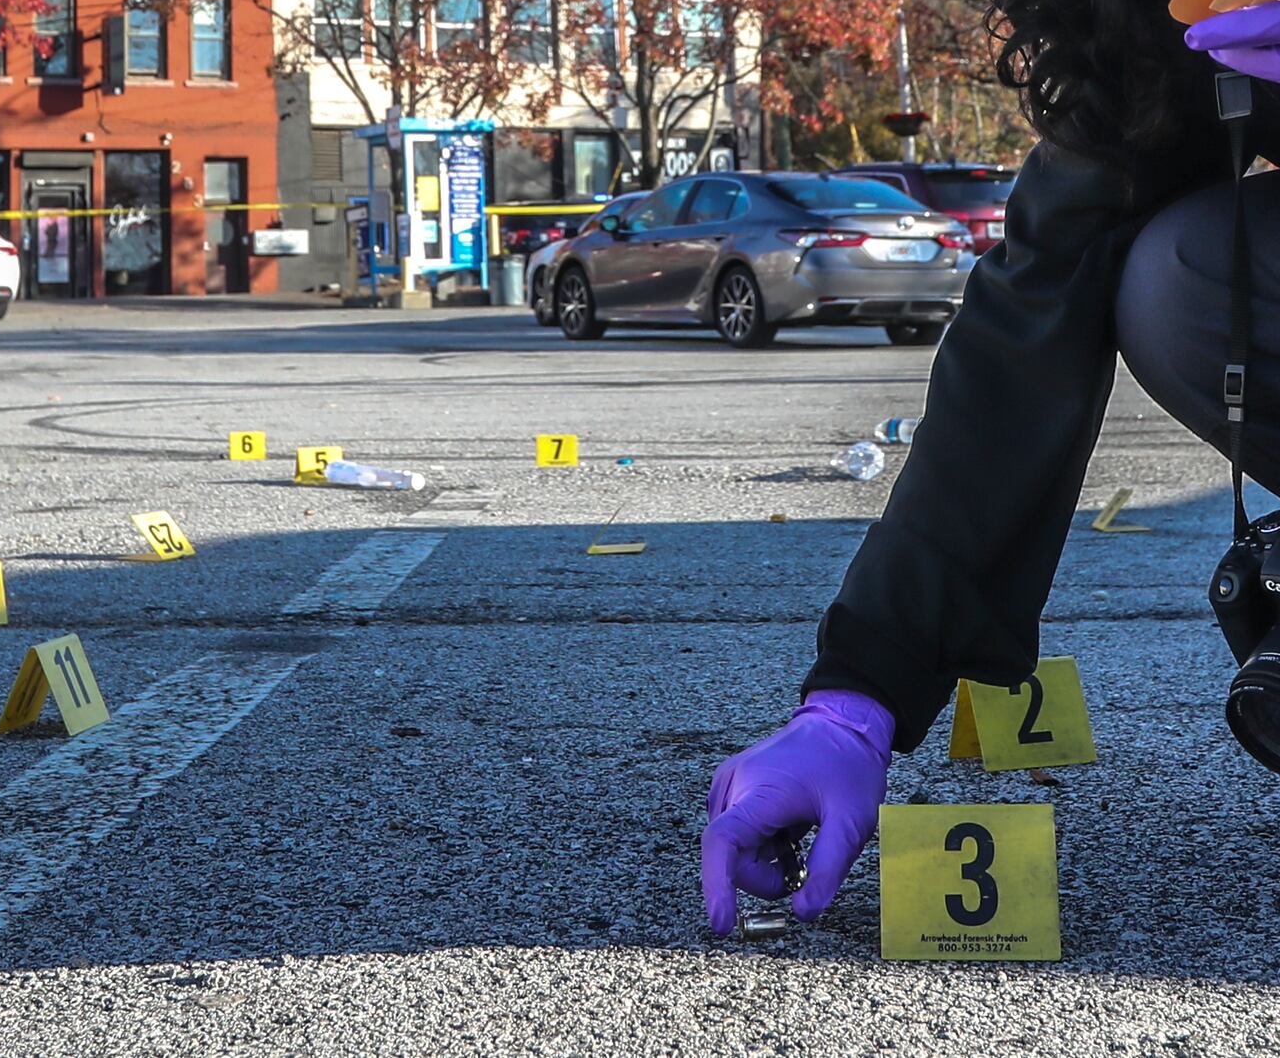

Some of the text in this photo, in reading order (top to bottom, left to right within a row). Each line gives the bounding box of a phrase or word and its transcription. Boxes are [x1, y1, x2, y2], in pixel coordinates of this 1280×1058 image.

[241, 435, 253, 453] 6
[551, 439, 563, 459] 7
[315, 451, 328, 475] 5
[149, 523, 183, 553] 25
[54, 646, 91, 708] 11
[1009, 675, 1053, 744] 2
[944, 822, 999, 927] 3
[920, 933, 1028, 943] Arrowhead Forensic Products
[938, 943, 1011, 952] 800-953-3274
